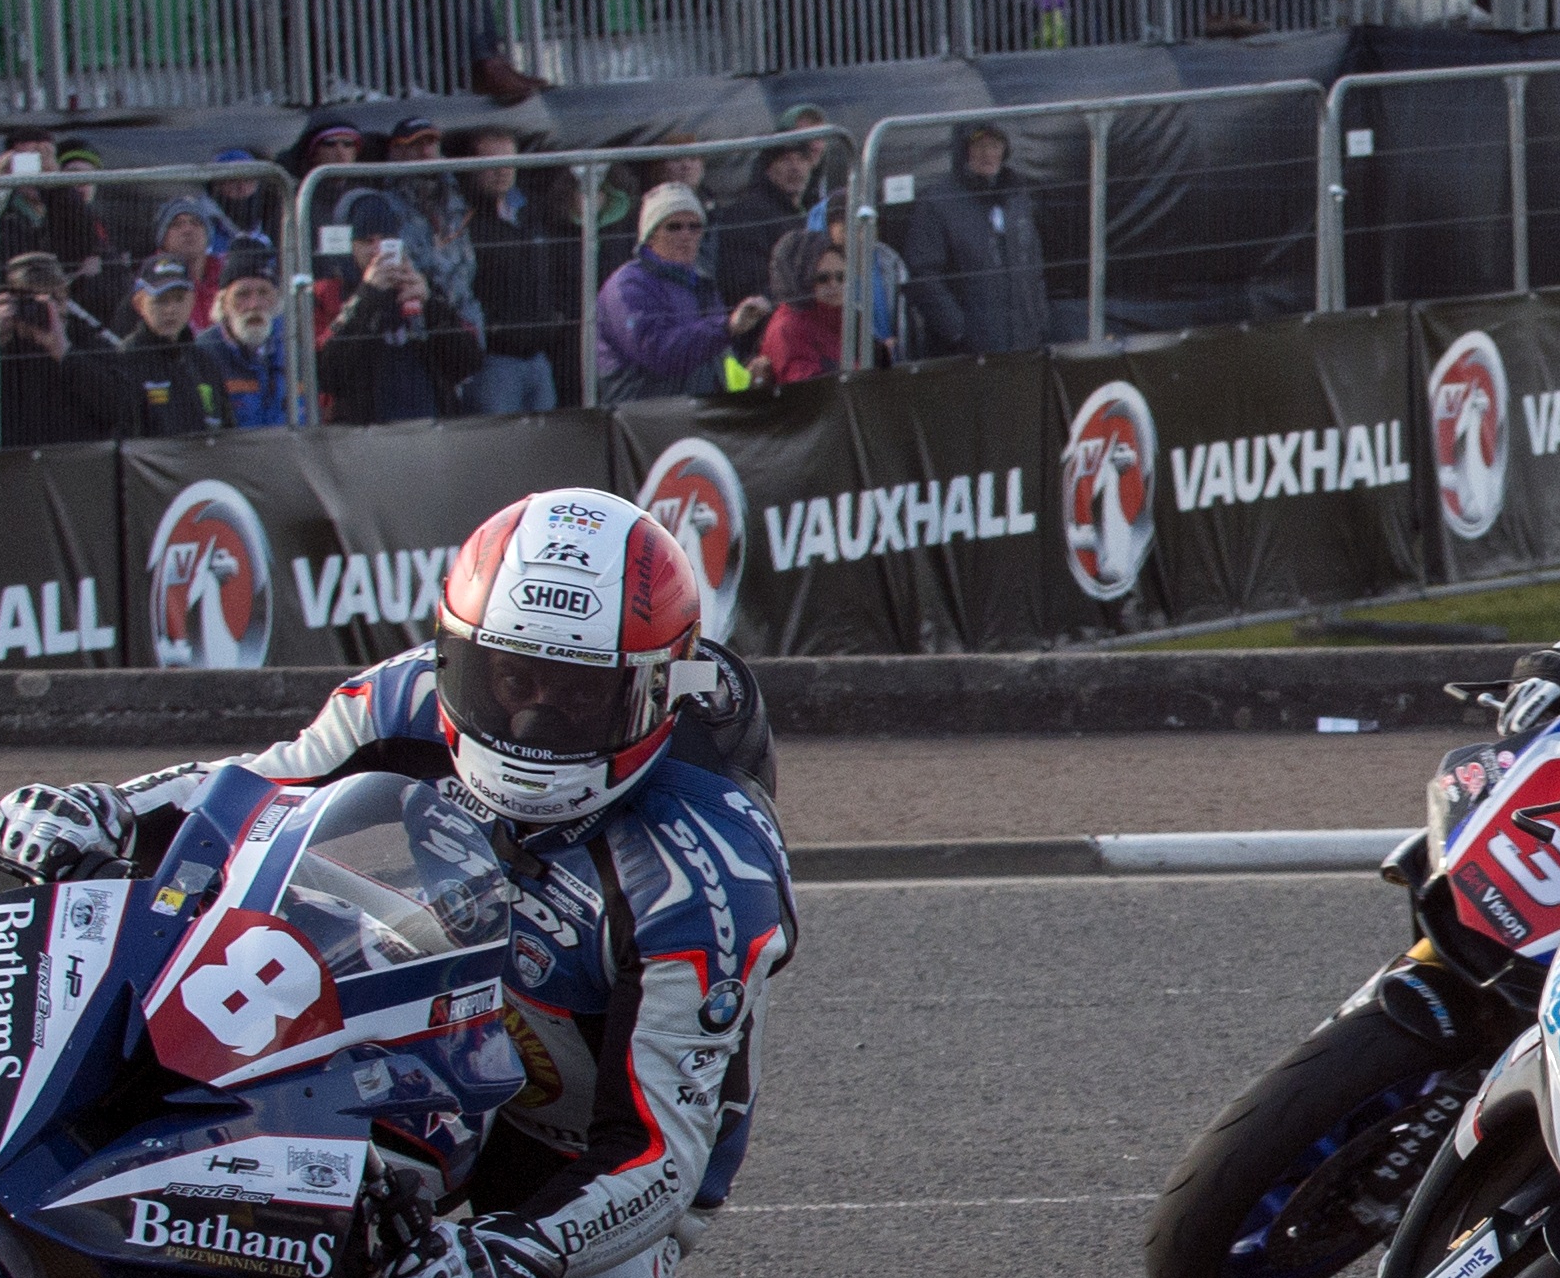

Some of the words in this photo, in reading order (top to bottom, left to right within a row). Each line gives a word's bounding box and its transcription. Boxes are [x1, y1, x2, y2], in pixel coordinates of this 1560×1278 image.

[1170, 420, 1410, 512] VAUXHALL
[548, 522, 597, 535] group
[550, 502, 607, 523] ebc
[764, 467, 1036, 572] VAUXHALL
[521, 586, 591, 615] SHOEI
[491, 737, 553, 761] ANCHOR
[442, 779, 493, 820] SHOEI
[66, 953, 86, 998] HP
[181, 926, 321, 1056] 8
[207, 1155, 262, 1175] HP
[165, 1243, 269, 1275] PRIZEWINNING
